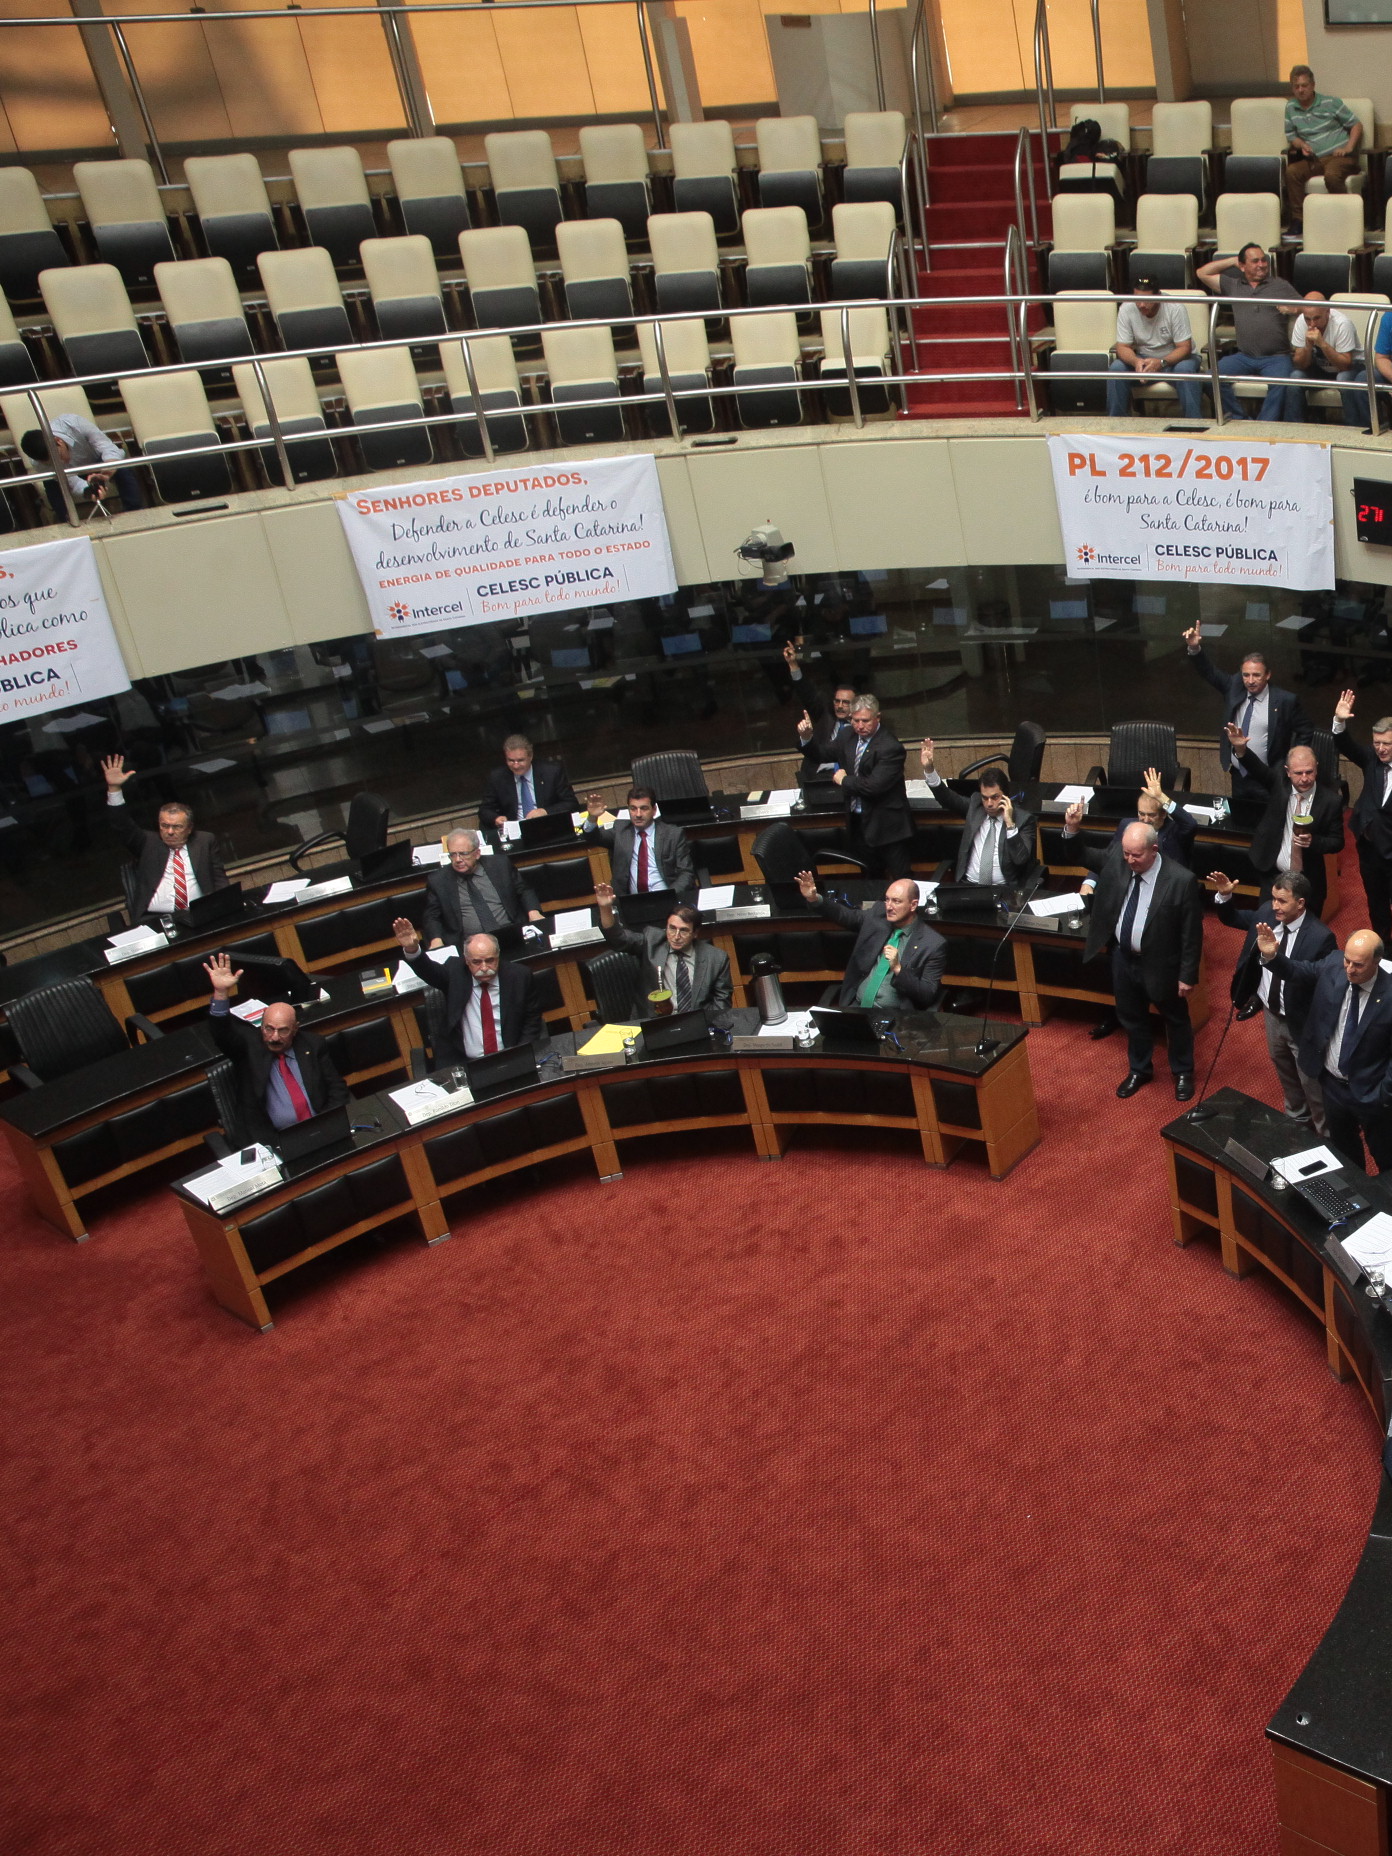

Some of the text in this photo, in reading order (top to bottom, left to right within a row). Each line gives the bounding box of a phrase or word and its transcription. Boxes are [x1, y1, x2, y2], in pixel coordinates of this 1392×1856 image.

[1067, 448, 1270, 482] PL 212/2017
[356, 472, 589, 516] SENHORES DEPUTADOS,
[1084, 485, 1301, 519] é bom para a Celesc, é bom para
[392, 495, 618, 543] Defender a Celesc é defender o
[1140, 513, 1248, 533] Santa Catarina!
[375, 514, 644, 570] desenvolvimento de Santa Catarina!
[1155, 544, 1278, 561] CELESC PÚBLICA
[378, 540, 651, 589] ENERGIA DE QUALIDADE PARA TODO O ESTADO
[1097, 553, 1141, 565] Intercel
[1157, 559, 1283, 579] Bom para todo mundo!
[476, 566, 614, 598] CELESC PÚBLICA
[24, 587, 58, 615] que
[412, 601, 463, 619] Intercel
[481, 580, 620, 615] Bom para todo mundo!
[42, 610, 88, 630] como
[0, 668, 61, 693] BLICA
[14, 680, 70, 708] mundo!
